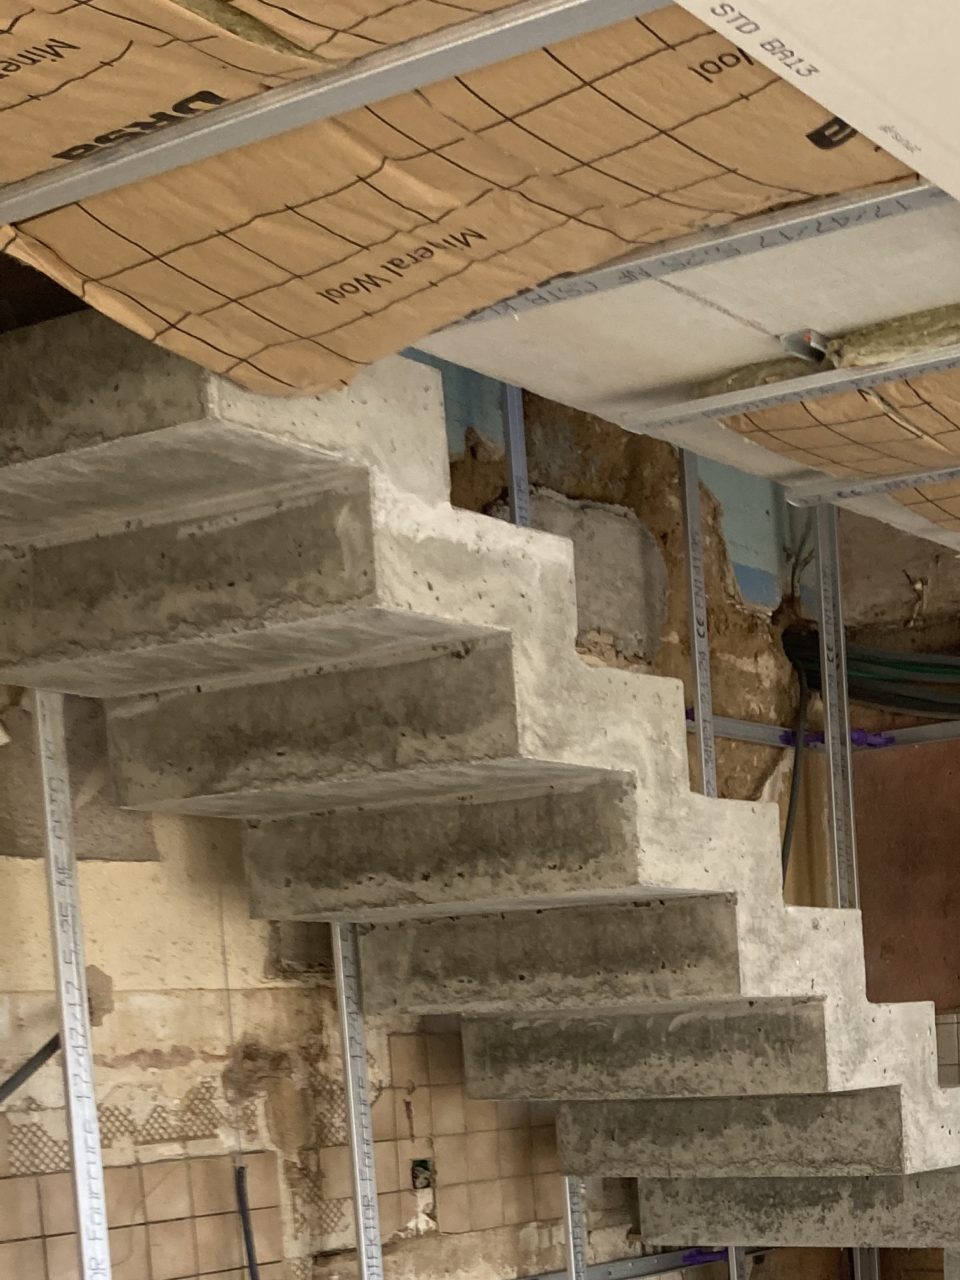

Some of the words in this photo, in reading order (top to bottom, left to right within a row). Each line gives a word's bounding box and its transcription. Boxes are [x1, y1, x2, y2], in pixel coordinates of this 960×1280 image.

[710, 3, 760, 34] STD
[760, 38, 820, 78] BA13
[380, 228, 487, 277] Mineral
[316, 273, 392, 305] Wool
